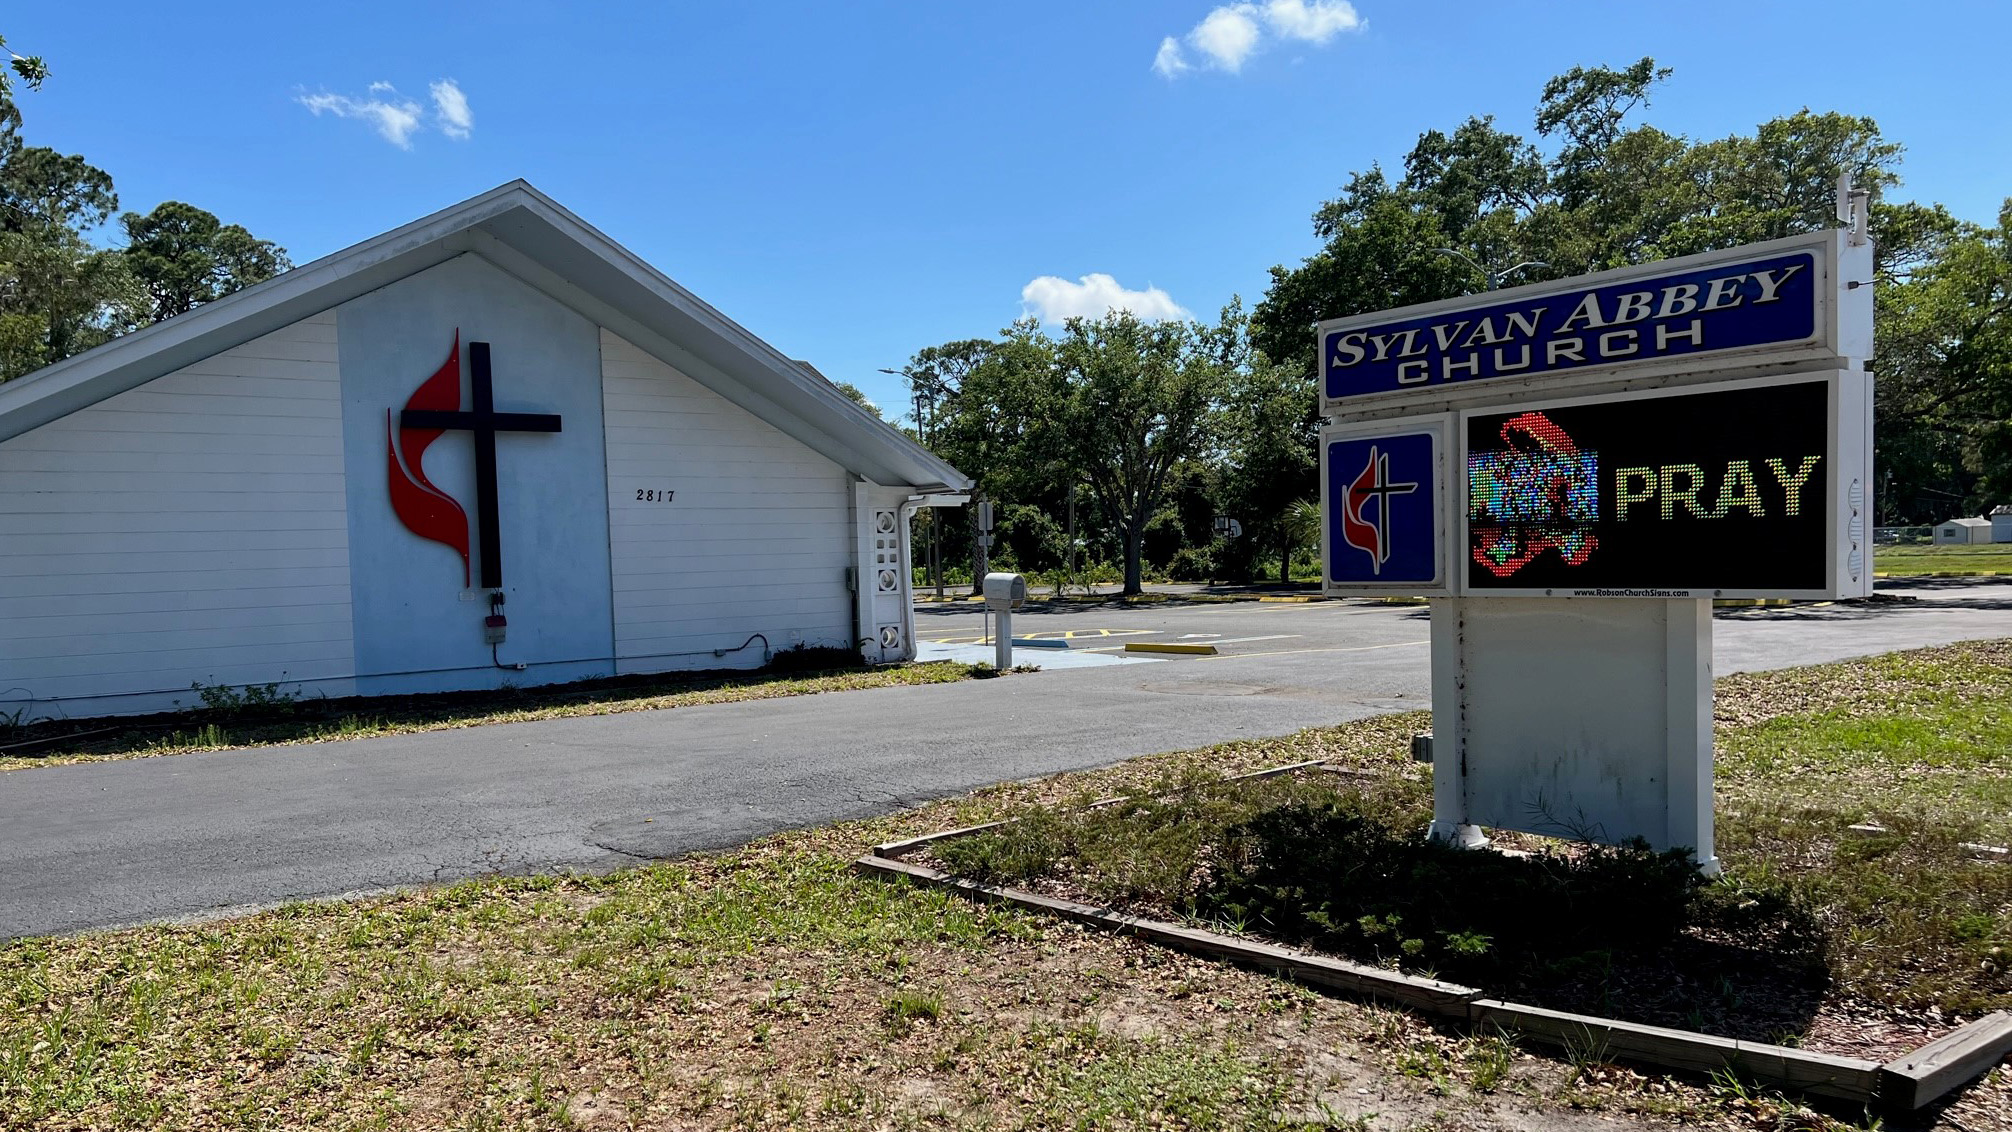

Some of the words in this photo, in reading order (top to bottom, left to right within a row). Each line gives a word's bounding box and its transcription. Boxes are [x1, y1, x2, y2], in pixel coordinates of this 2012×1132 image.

[1553, 263, 1805, 334] ABBEY
[1397, 319, 1702, 384] CHURCH
[636, 489, 675, 502] 2817
[1616, 455, 1821, 521] PRAY
[1573, 588, 1689, 597] www.RobsonChurchSigns.com
